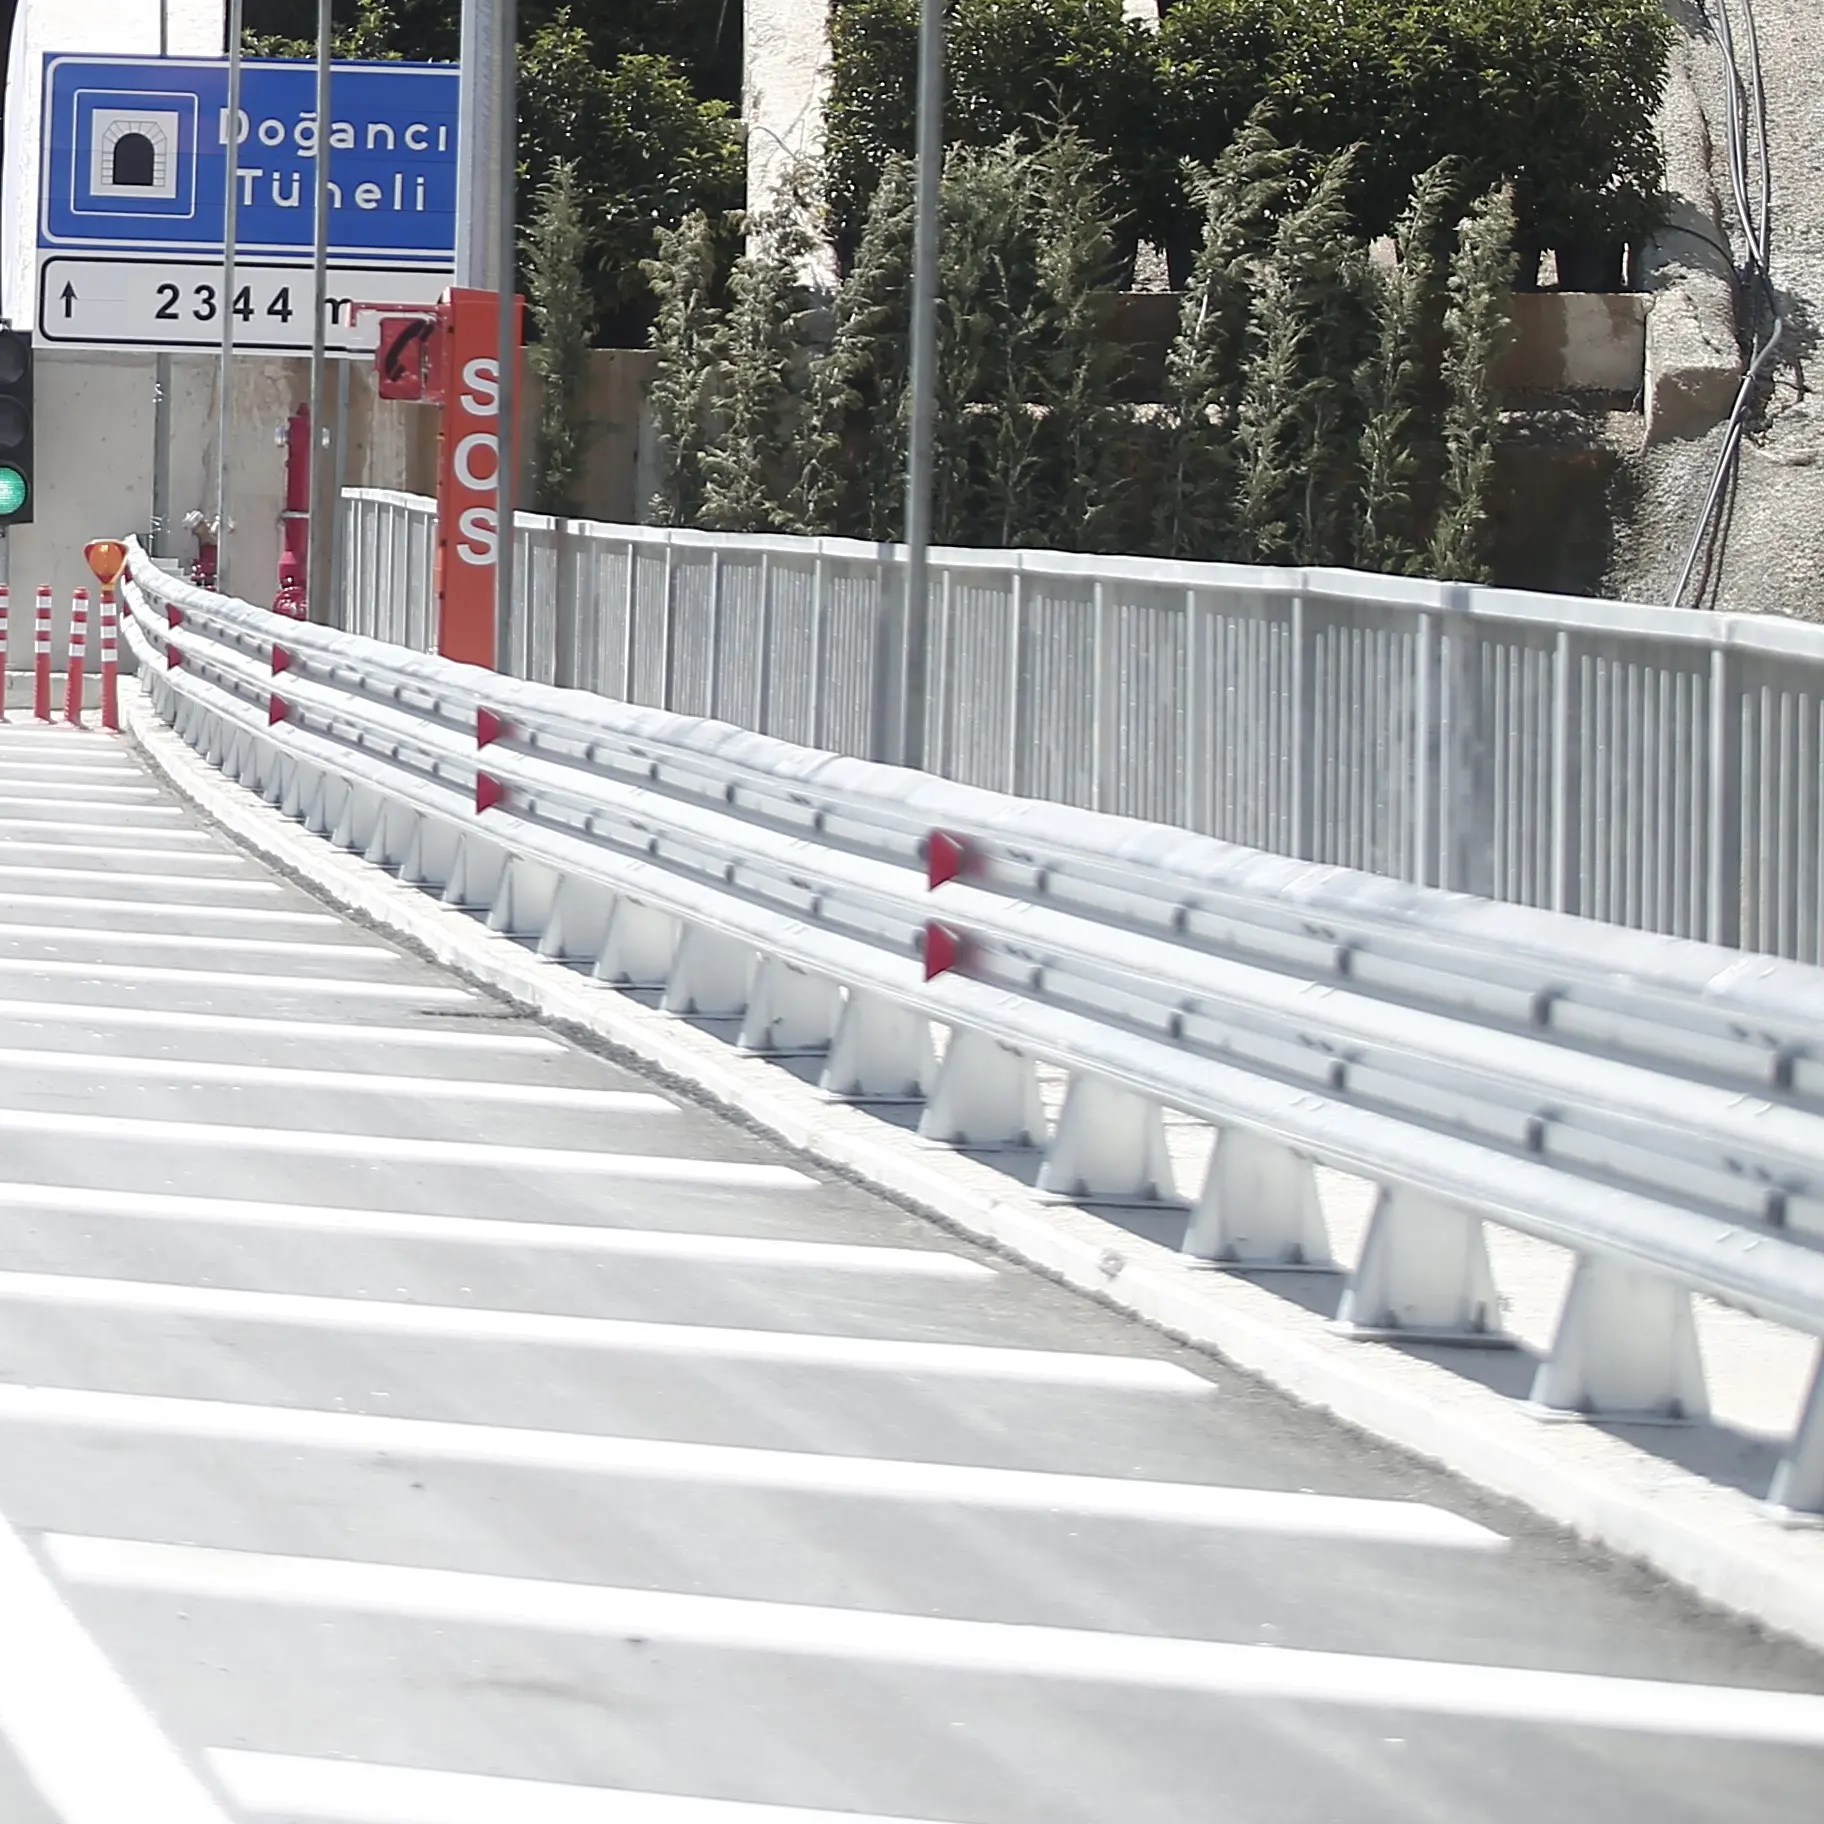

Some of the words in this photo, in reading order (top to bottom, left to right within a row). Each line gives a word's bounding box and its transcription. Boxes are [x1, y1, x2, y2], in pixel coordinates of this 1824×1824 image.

[218, 108, 447, 157] Doğancı
[236, 168, 425, 211] Tüneli
[155, 283, 293, 323] 2344
[454, 356, 500, 566] SOS
